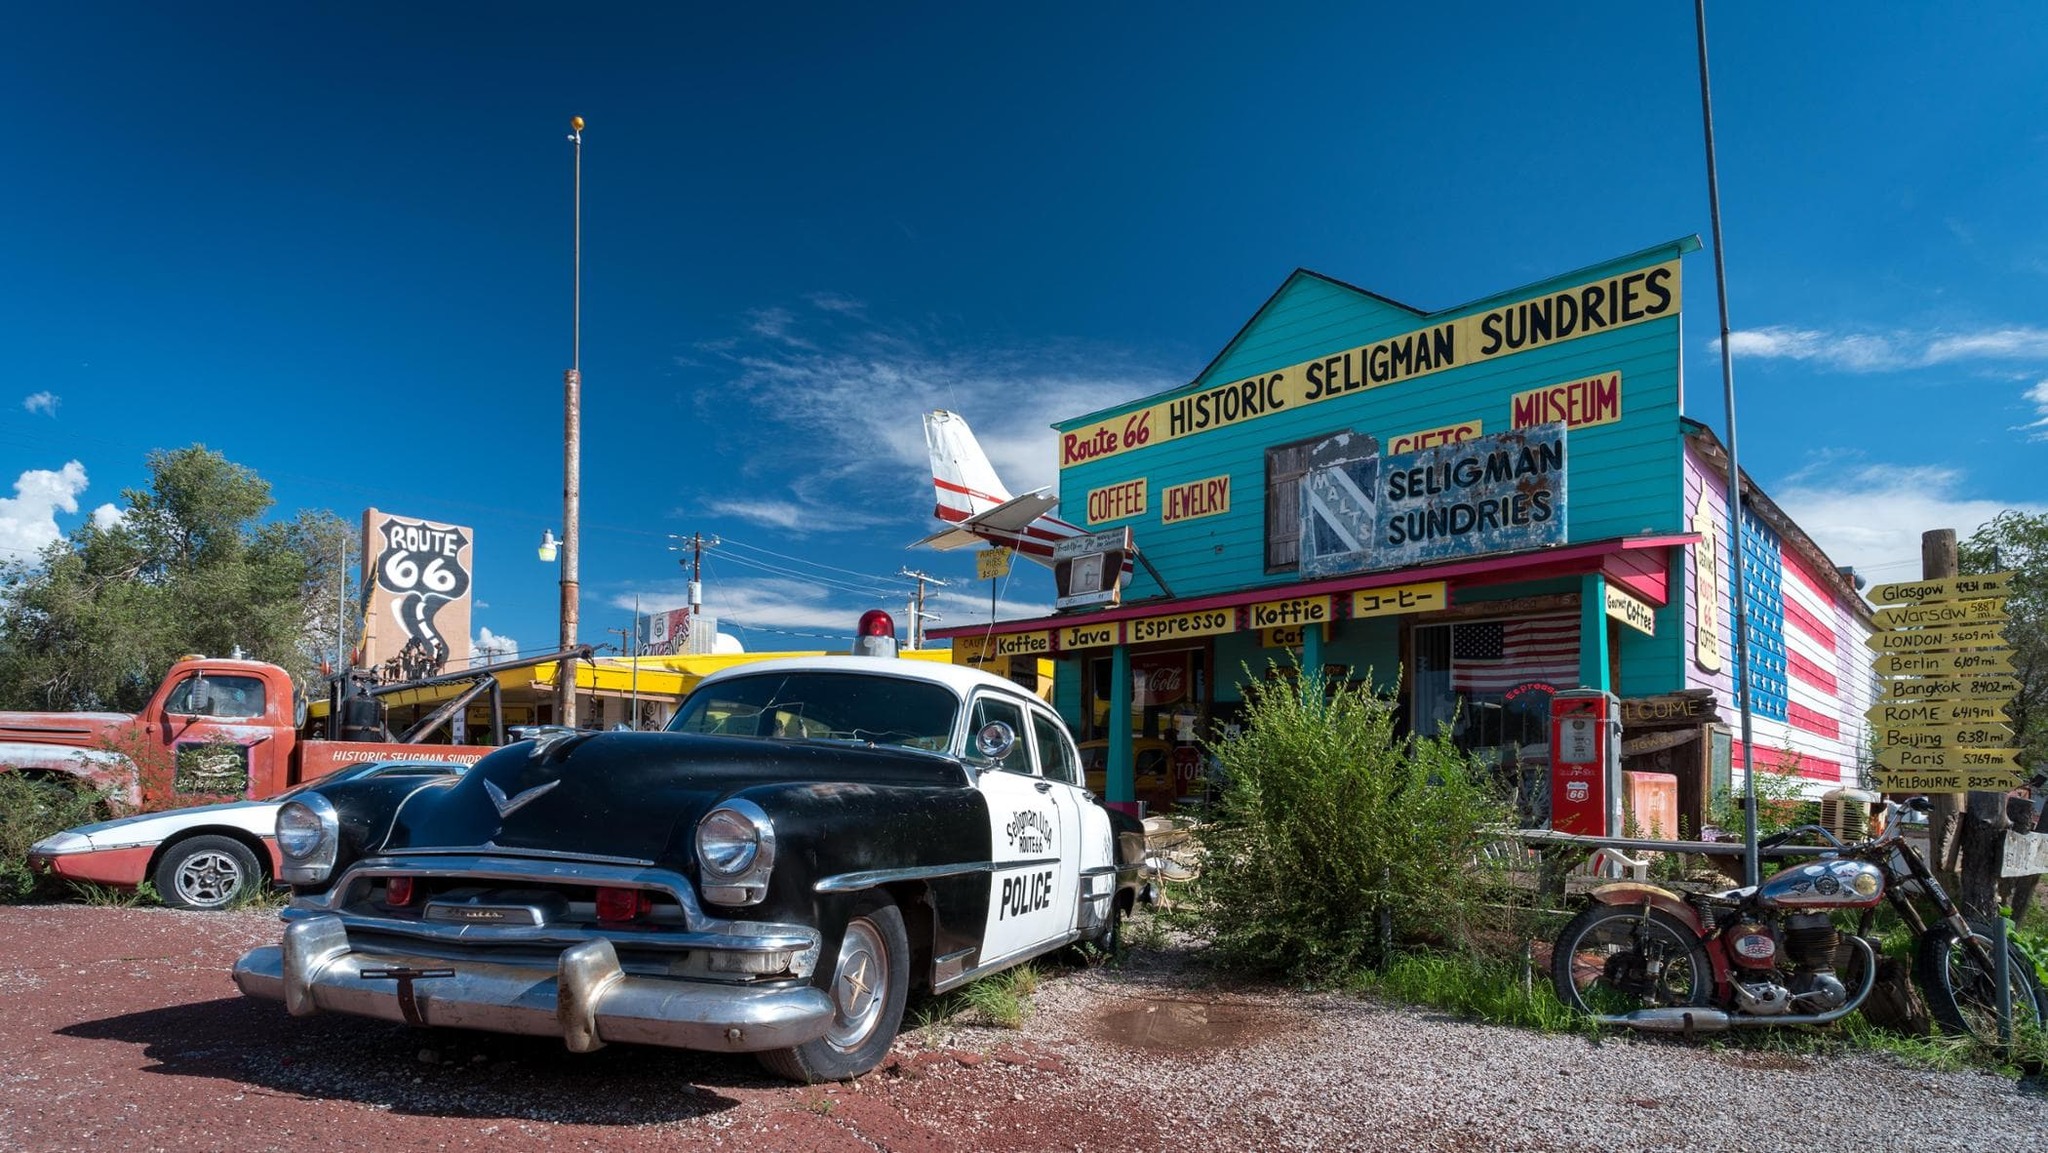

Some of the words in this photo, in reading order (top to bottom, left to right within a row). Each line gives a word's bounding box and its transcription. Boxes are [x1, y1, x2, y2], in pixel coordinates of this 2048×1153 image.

[1064, 427, 1118, 465] Route
[1123, 410, 1150, 448] 66
[1169, 374, 1285, 436] HISTORIC
[1305, 325, 1455, 400] SELIGMAN
[1481, 267, 1672, 355] SUNDRIES
[1514, 376, 1618, 430] MUSEUM
[1394, 427, 1473, 454] GIFTS
[1388, 439, 1563, 502] SELIGMAN
[1089, 481, 1144, 522] COFFEE
[1164, 477, 1228, 521] JEWELRY
[1313, 472, 1370, 540] MALTS
[1388, 490, 1553, 545] SUNDRIES
[390, 526, 458, 557] ROUTE
[385, 549, 457, 592] 66
[1363, 590, 1432, 611] コーヒー
[1699, 576, 1713, 605] ROUTE
[1883, 584, 1944, 601] Glasgow
[1134, 611, 1226, 641] Espresso
[1255, 600, 1324, 627] Koffie
[1626, 600, 1652, 631] Coffee
[1704, 604, 1711, 628] 66
[1886, 607, 1967, 625] Warsaw
[1970, 601, 1996, 612] 5887
[997, 636, 1047, 655] Kaffee
[1068, 628, 1111, 647] Java
[1700, 626, 1716, 655] COFFEE
[1884, 633, 1942, 648] LONDON
[1891, 657, 1939, 672] Berlin
[1150, 667, 1182, 692] Cola
[1893, 682, 1961, 697] Bangkok
[1885, 707, 1940, 722] ROME
[1887, 730, 1942, 747] Beijing
[333, 751, 387, 762] HISTORIC
[390, 753, 444, 763] SELIGMAN
[1901, 751, 1945, 766] Paris
[1569, 790, 1586, 799] 66
[1887, 775, 1962, 789] MELBOURNE
[1000, 871, 1052, 921] POLICE
